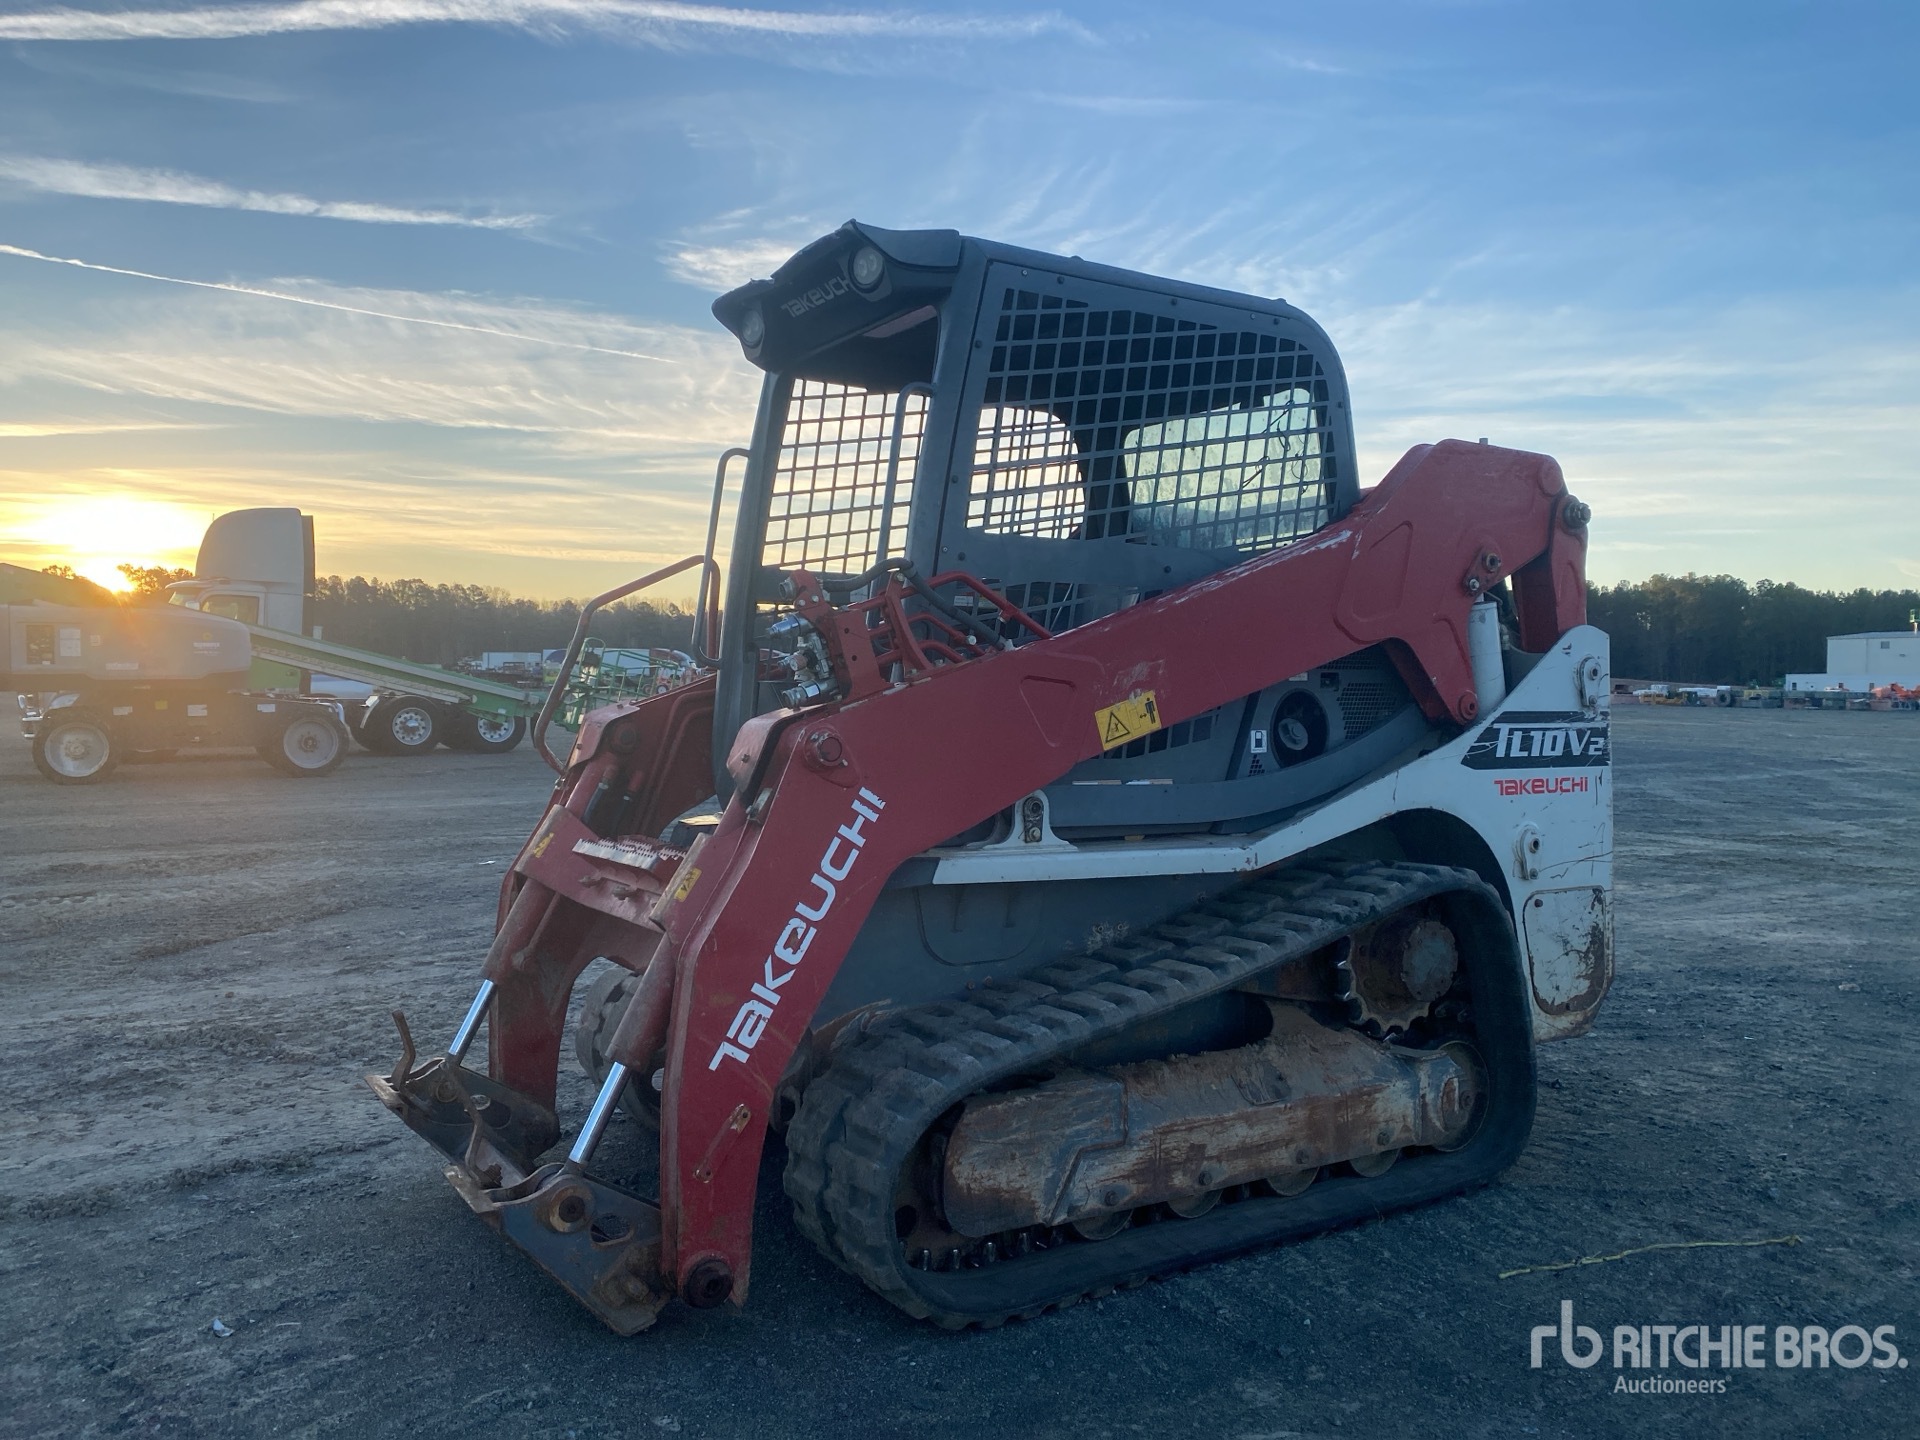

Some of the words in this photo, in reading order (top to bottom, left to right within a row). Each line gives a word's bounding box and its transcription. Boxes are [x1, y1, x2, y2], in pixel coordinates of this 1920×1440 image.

[781, 276, 849, 318] TAKEUCH
[1494, 776, 1588, 796] TAKEUCHI
[708, 786, 887, 1071] TAKEUCHI
